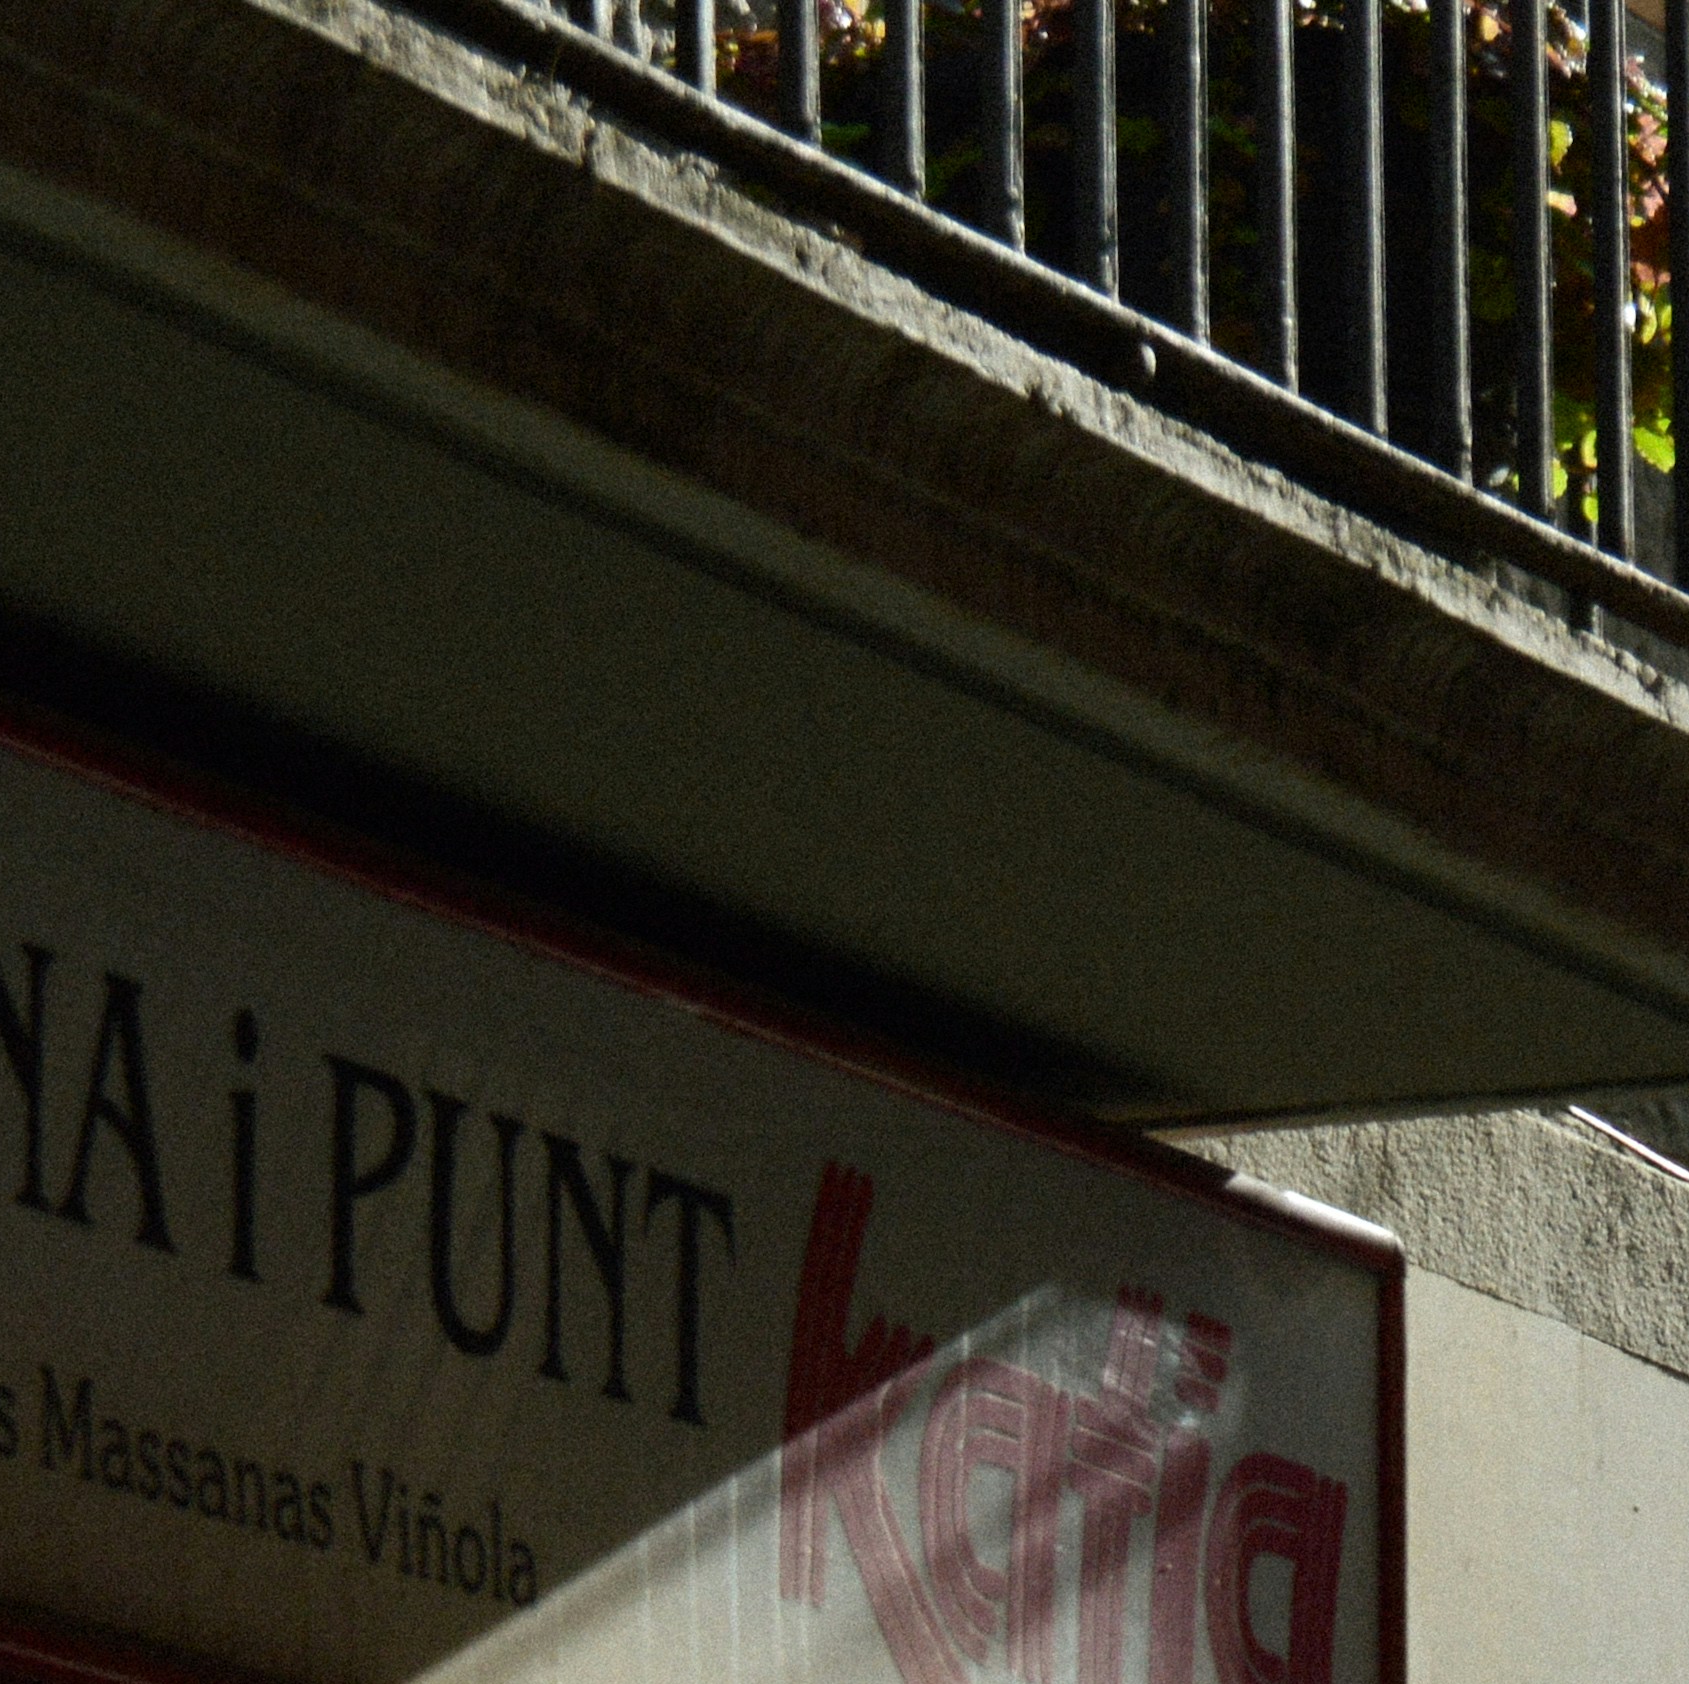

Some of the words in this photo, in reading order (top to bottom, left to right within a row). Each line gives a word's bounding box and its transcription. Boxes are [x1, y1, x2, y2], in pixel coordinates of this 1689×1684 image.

[228, 1007, 262, 1283] i
[321, 1053, 739, 1427] PUNT
[38, 1364, 335, 1552] Massanas
[350, 1457, 538, 1605] Viñola
